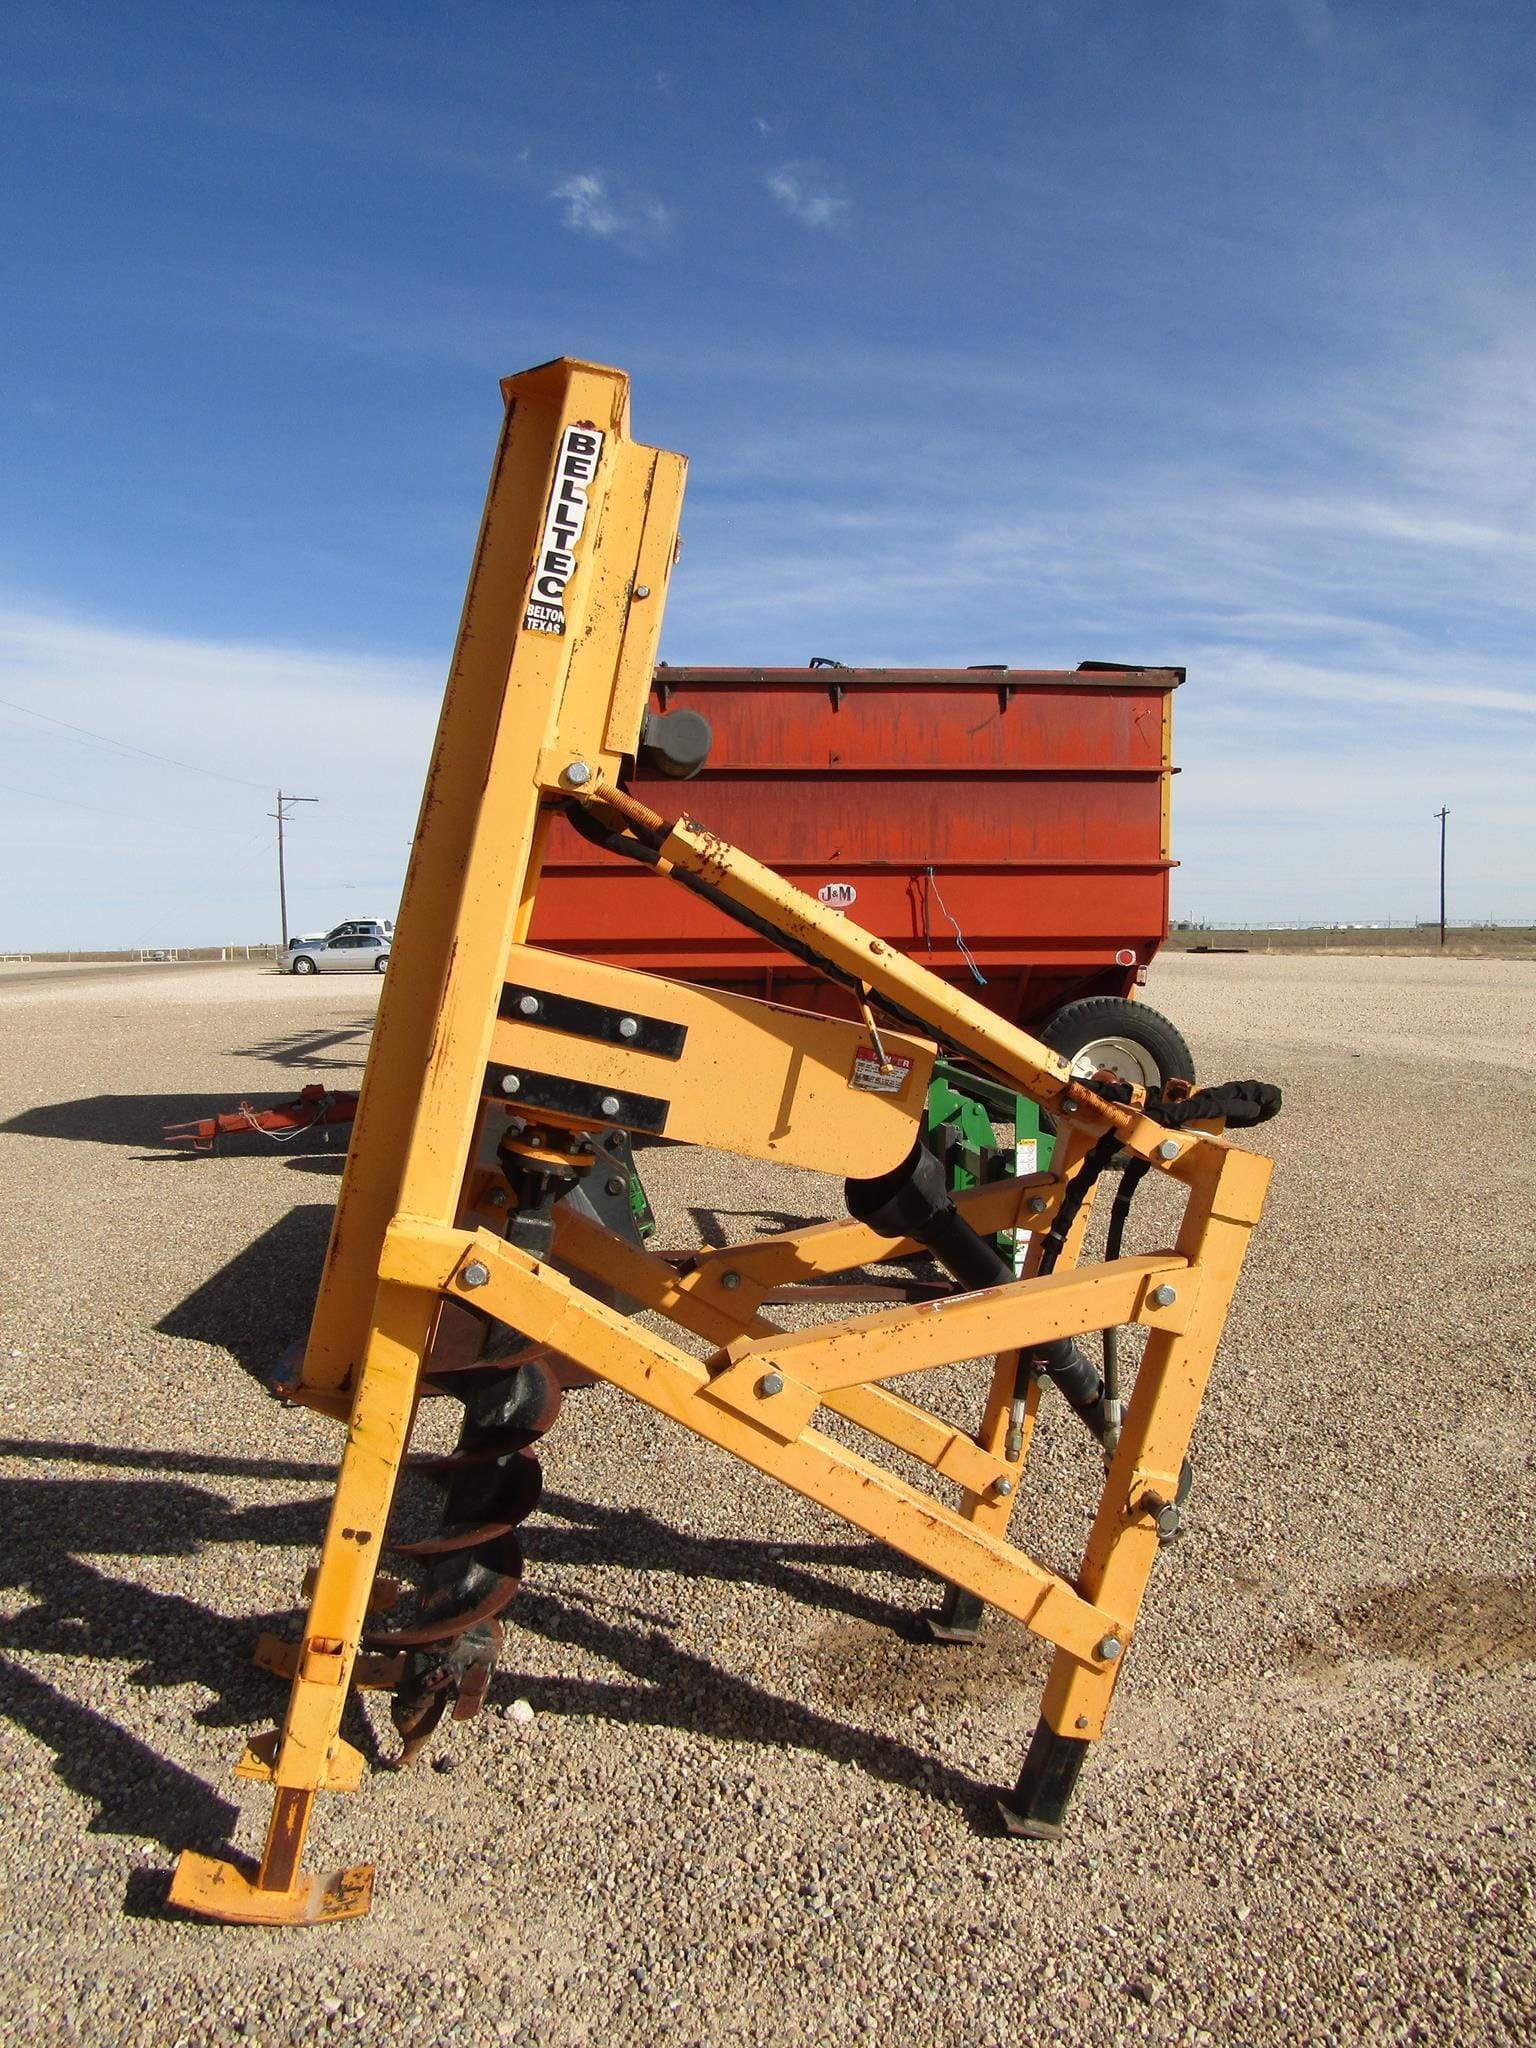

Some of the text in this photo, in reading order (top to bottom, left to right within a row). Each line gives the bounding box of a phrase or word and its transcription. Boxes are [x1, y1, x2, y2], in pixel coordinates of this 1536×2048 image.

[537, 432, 597, 599] BELLTEC
[526, 603, 565, 624] BELTON
[526, 617, 561, 635] TEXAS
[821, 886, 852, 902] J&M
